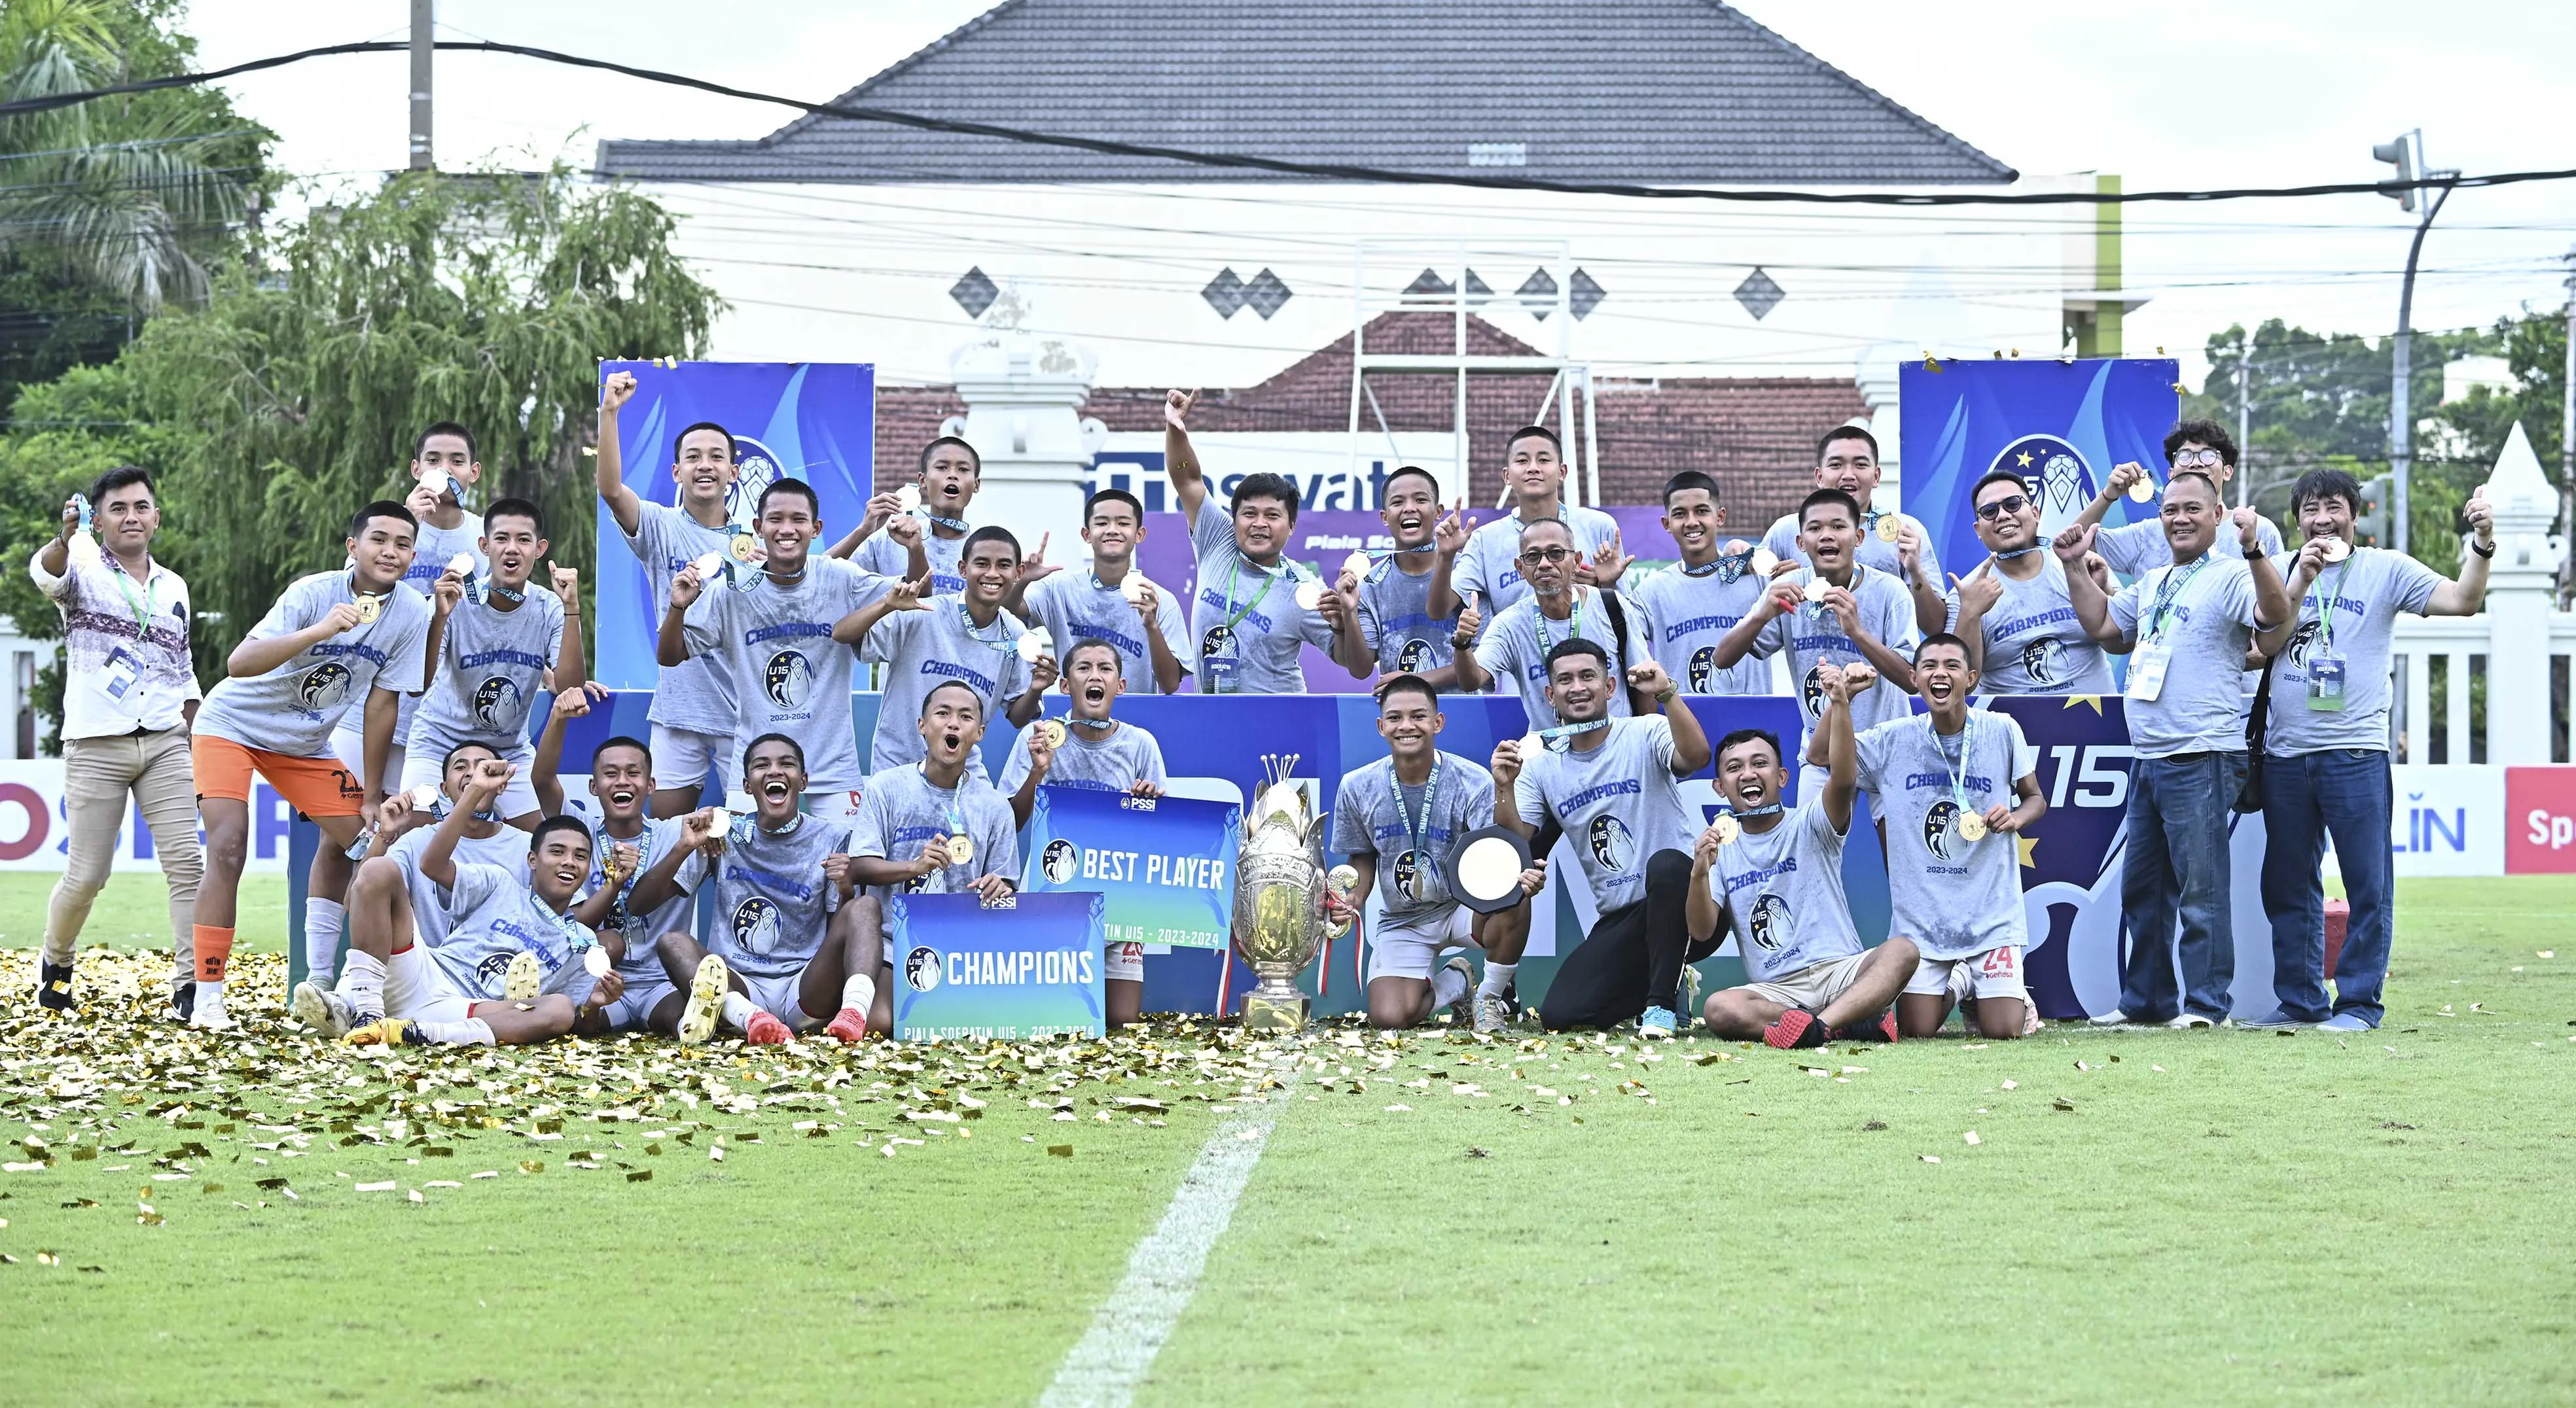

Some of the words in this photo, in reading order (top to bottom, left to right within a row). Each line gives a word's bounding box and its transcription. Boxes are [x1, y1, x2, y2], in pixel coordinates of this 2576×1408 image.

[1994, 607, 2079, 642] CHAMPION
[745, 622, 833, 646] CHAMPIONS
[1206, 637, 1222, 648] U15
[2025, 646, 2045, 658] U15
[460, 649, 545, 670] CHAMPIONS
[1401, 655, 1418, 664] U15
[1691, 661, 1709, 671] U15
[769, 665, 789, 675] U15
[312, 671, 332, 683] U15
[920, 659, 995, 698] CHAMPIONS
[1807, 679, 1821, 688] U1
[2283, 674, 2308, 683] 2023-2
[479, 690, 497, 699] U15
[770, 713, 811, 722] 2023-2024
[1579, 718, 1606, 731] 2023-2024
[1390, 769, 1403, 800] CHAMPION
[1131, 797, 1156, 811] PSSI
[1418, 803, 1431, 834] CHAMPION
[1426, 767, 1439, 803] 2023-2024
[1558, 779, 1641, 819] CHAMPIONS
[1928, 815, 1946, 825] U15
[1592, 831, 1607, 842] U15
[639, 831, 651, 864] 2023-2024
[1082, 848, 1139, 883] BEST
[1146, 854, 1226, 890] PLAYER
[1397, 864, 1415, 873] U15
[1926, 866, 1968, 875] 2023-2024
[1605, 872, 1641, 888] 2023-2024
[991, 897, 1016, 908] PSSI
[739, 908, 760, 921] U15
[1751, 910, 1768, 922] U15
[1125, 924, 1143, 940] U15
[1157, 928, 1219, 947] 2023-2024
[732, 952, 772, 965] 2023-2024
[908, 957, 923, 966] U15
[1763, 946, 1800, 970] 2023-2024
[1983, 945, 2013, 971] 24
[488, 956, 508, 975] U15
[947, 950, 1094, 985] CHAMPIONS
[904, 1025, 936, 1040] PIALA
[998, 1025, 1016, 1040] U15
